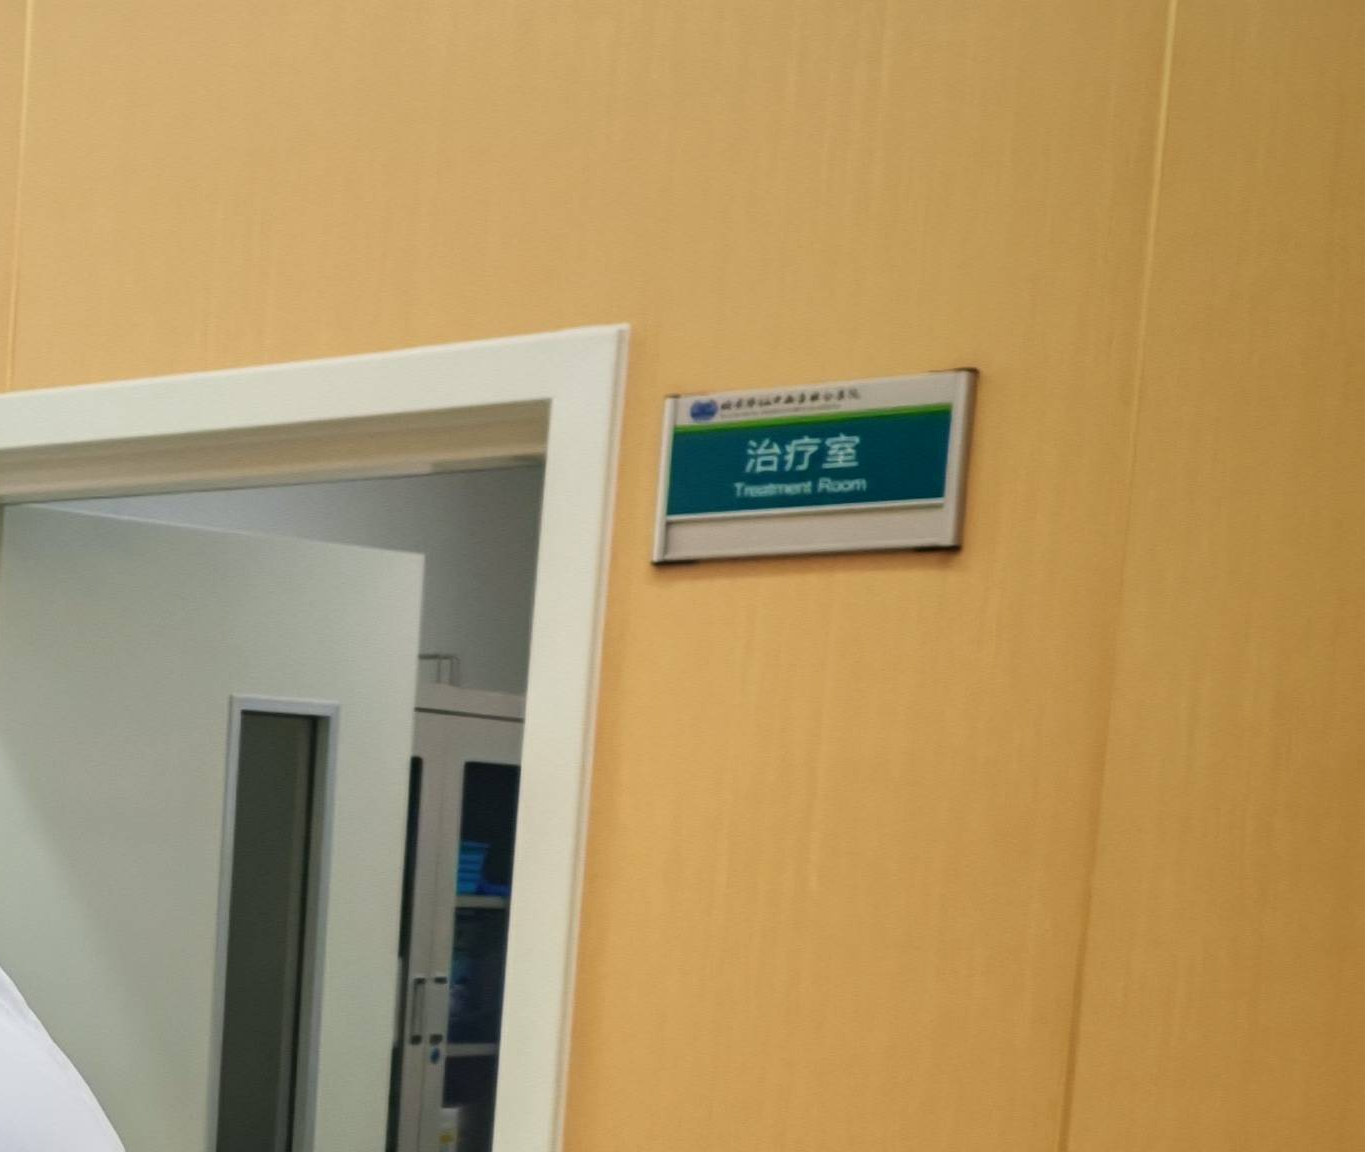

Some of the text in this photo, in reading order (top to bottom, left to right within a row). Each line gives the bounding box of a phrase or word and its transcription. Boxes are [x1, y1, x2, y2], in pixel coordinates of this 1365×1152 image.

[746, 434, 859, 473] 治疗室
[735, 478, 866, 497] Treatment Room
